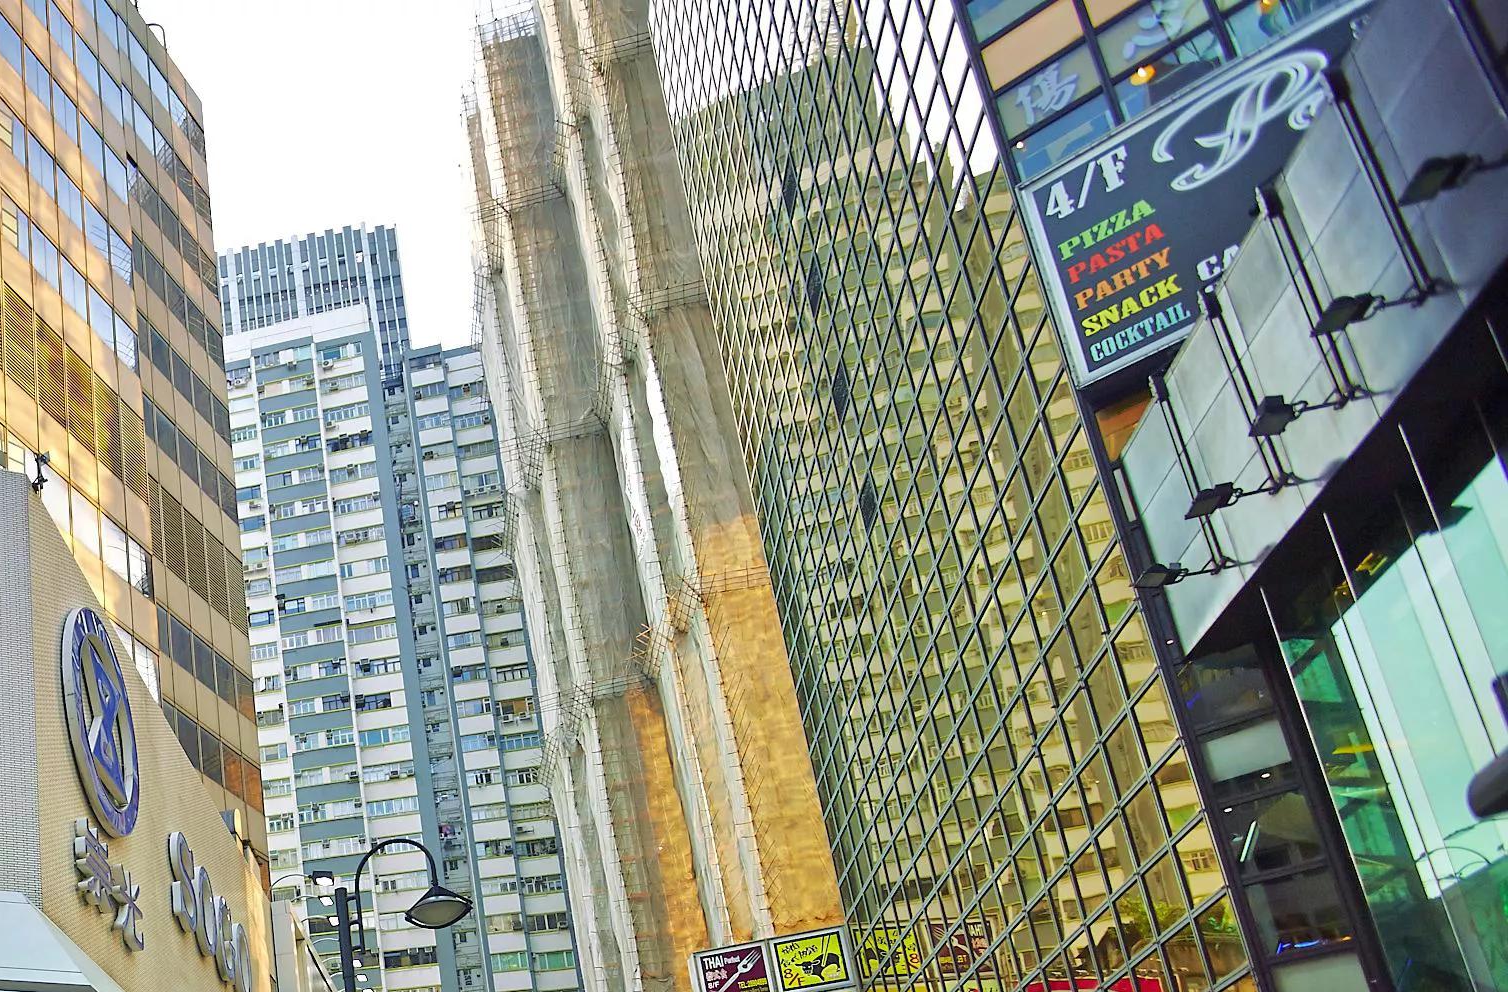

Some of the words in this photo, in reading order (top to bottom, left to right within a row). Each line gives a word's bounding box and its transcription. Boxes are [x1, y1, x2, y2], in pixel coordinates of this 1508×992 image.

[1045, 145, 1128, 220] 4/F
[1058, 199, 1156, 261] PIZZA
[1067, 223, 1165, 284] PASTA
[1074, 247, 1171, 311] PARTY
[1081, 274, 1182, 338] SNACK
[1089, 301, 1191, 363] COCKTAIL
[74, 818, 144, 950] 崇光
[703, 955, 724, 970] THAI
[783, 968, 805, 986] 8/F
